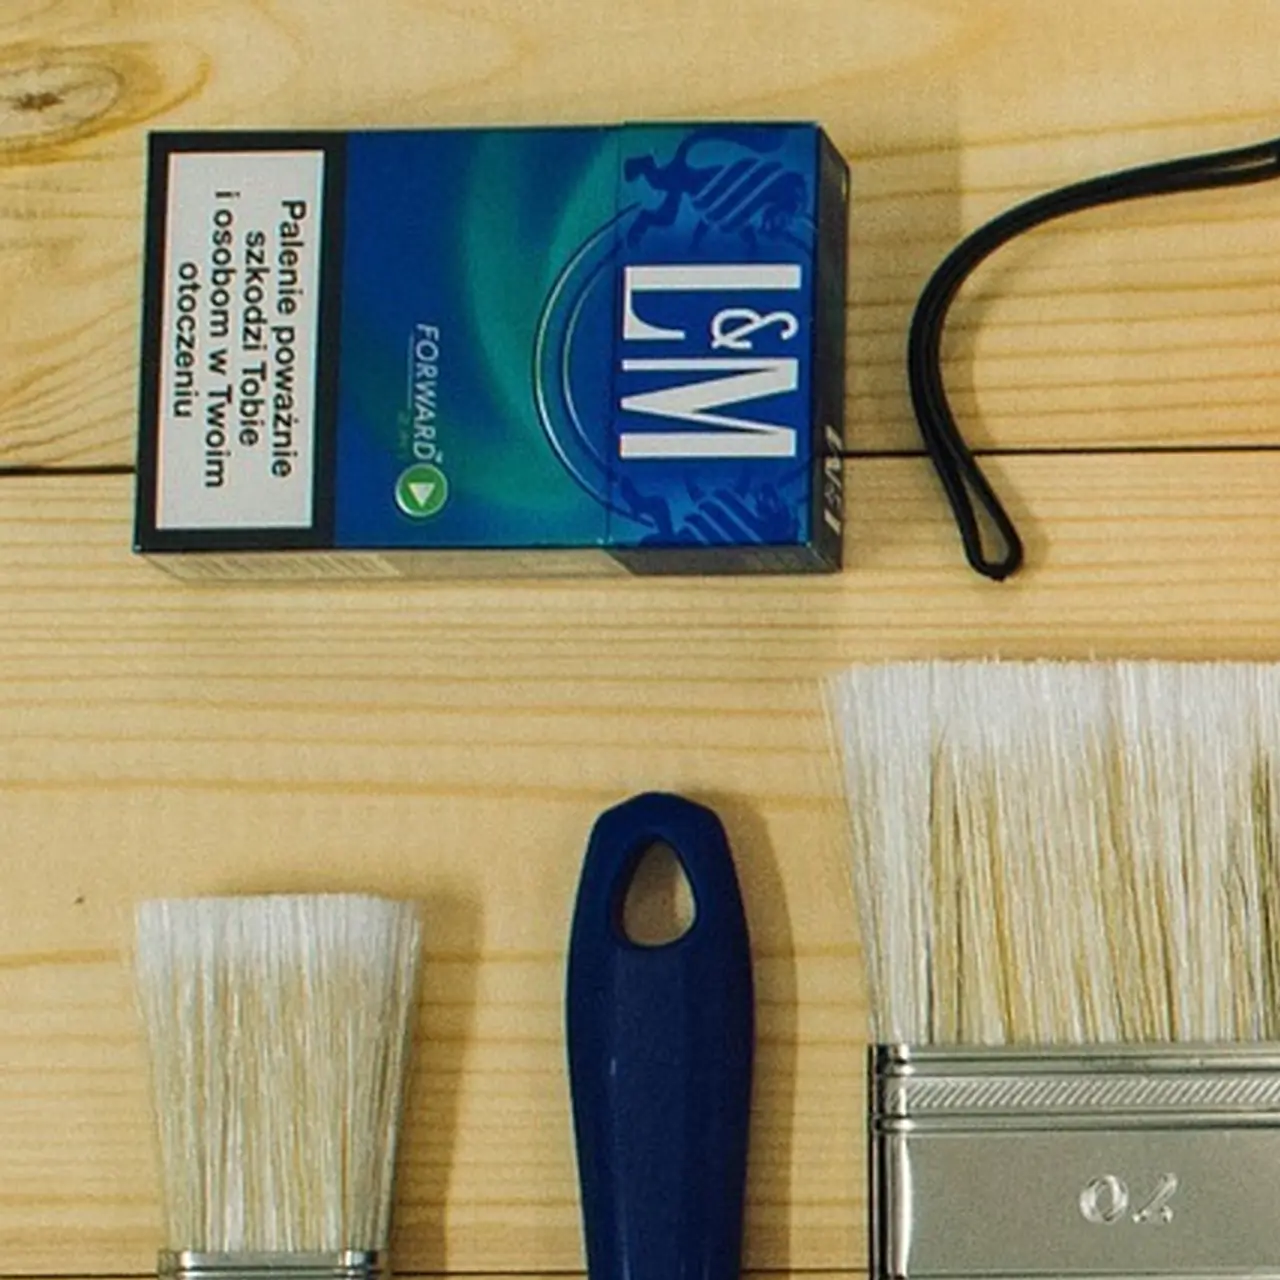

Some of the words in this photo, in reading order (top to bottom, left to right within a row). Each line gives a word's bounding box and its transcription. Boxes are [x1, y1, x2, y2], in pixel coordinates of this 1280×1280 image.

[215, 190, 241, 198] i
[209, 208, 238, 338] osobom
[242, 230, 270, 351] szkodzi
[277, 199, 307, 315] Palenie
[172, 262, 202, 418] otoczeniu
[208, 349, 227, 375] w
[412, 322, 440, 461] FORWARD
[619, 264, 802, 459] L&M
[205, 384, 233, 488] Twoim
[239, 362, 268, 447] Tobie
[271, 325, 301, 479] poważnie
